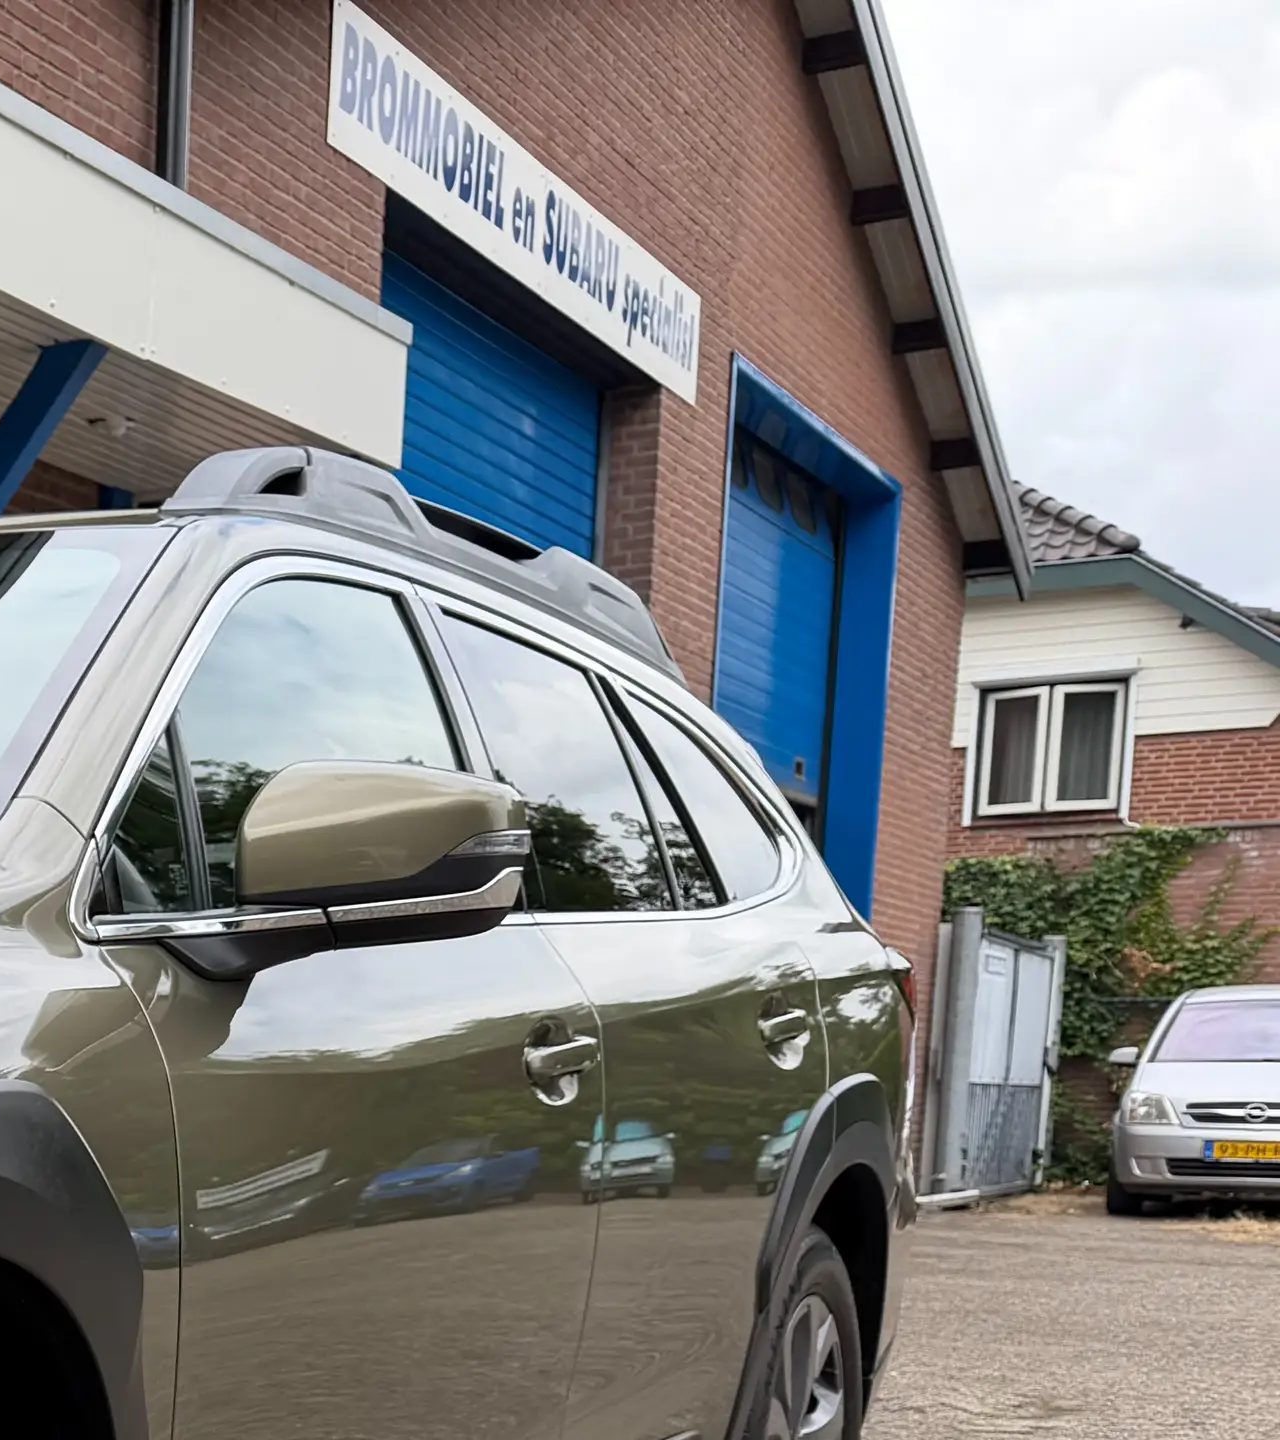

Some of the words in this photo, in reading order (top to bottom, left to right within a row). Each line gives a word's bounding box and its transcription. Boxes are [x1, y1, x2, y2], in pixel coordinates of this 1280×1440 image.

[338, 21, 505, 232] BROMMOBIEL
[512, 186, 536, 254] en
[543, 189, 621, 313] SUBARU
[621, 273, 696, 373] specialist
